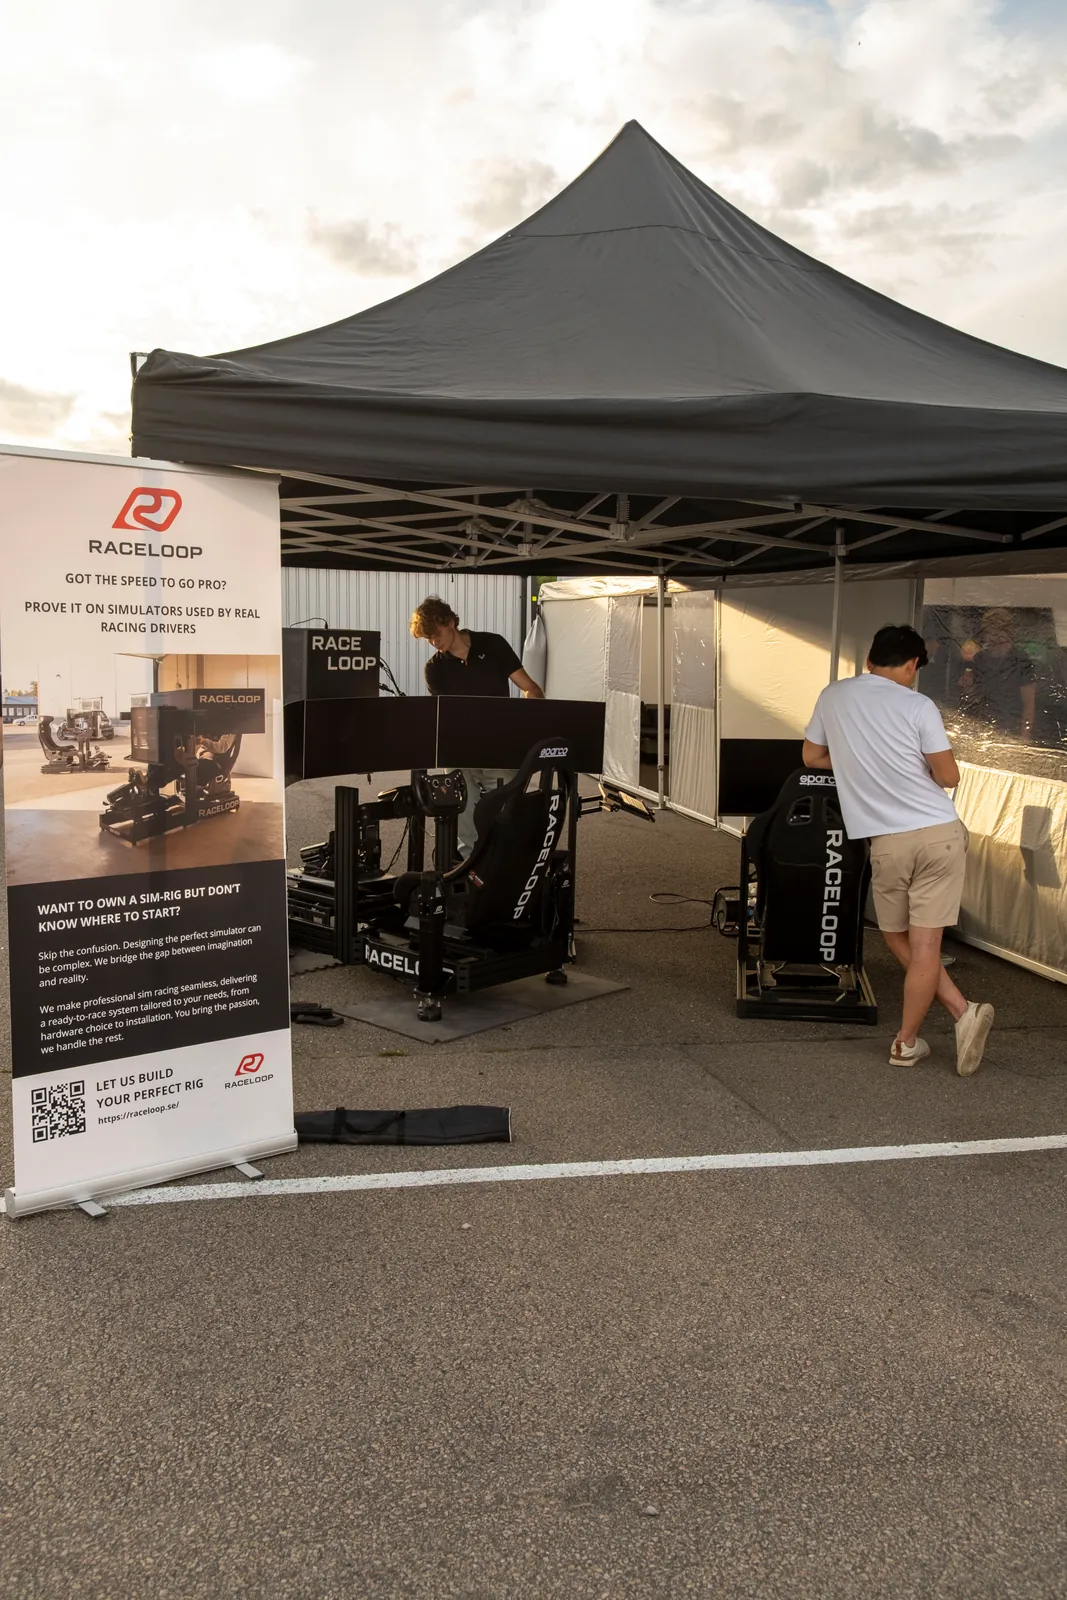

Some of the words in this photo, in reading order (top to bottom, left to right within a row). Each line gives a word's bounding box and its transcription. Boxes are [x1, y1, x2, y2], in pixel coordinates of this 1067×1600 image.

[89, 540, 202, 559] RACELOOP
[65, 573, 91, 584] GOT
[95, 574, 117, 585] THE
[121, 576, 157, 587] SPEED
[160, 577, 175, 588] TO
[178, 578, 194, 589] GO
[198, 579, 226, 590] PRO?
[25, 601, 66, 613] PROVE
[71, 603, 82, 613] IT
[86, 603, 104, 614] ON
[108, 604, 182, 616] SIMULATORS
[186, 607, 214, 617] USED
[218, 608, 231, 617] BY
[235, 608, 260, 618] REAL
[101, 622, 146, 632] RACING
[150, 623, 196, 634] DRIVERS
[312, 636, 361, 650] RACE
[328, 656, 376, 670] LOOP
[199, 695, 261, 703] RACELOOP
[800, 775, 836, 786] sparc
[198, 799, 239, 817] RACELOOP
[513, 795, 559, 919] RACELOOP
[37, 901, 75, 915] WANT
[77, 900, 93, 910] TO
[97, 896, 125, 908] OWN
[129, 895, 137, 905] A
[140, 890, 181, 904] SIM-RIG
[184, 887, 205, 898] BUT
[208, 883, 240, 896] DON'T
[819, 829, 843, 961] RACELOOP
[39, 918, 77, 932] KNOW
[80, 913, 120, 927] WHERE
[123, 911, 139, 922] TO
[142, 906, 180, 920] START?
[38, 951, 57, 961] Skip
[59, 949, 74, 957] the
[76, 943, 120, 955] confusion.
[123, 937, 163, 949] Designing
[165, 935, 178, 943] the
[180, 931, 208, 943] perfect
[210, 927, 246, 937] simulator
[39, 966, 50, 974] be
[52, 960, 92, 972] complex.
[94, 957, 108, 966] We
[110, 954, 137, 964] bridge
[139, 951, 153, 960] the
[154, 950, 170, 960] gap
[172, 945, 205, 955] between
[207, 938, 252, 950] imagination
[39, 977, 56, 987] and
[59, 974, 88, 984] reality.
[39, 1005, 54, 1014] We
[57, 1001, 81, 1011] make
[83, 991, 135, 1009] professional
[137, 990, 152, 999] sim
[154, 986, 179, 996] racing
[180, 980, 218, 992] seamless,
[220, 974, 257, 986] delivering
[48, 1011, 106, 1026] ready-to-race
[108, 1006, 138, 1018] system
[140, 998, 171, 1011] tailored
[183, 995, 202, 1006] your
[204, 990, 229, 1000] needs,
[231, 988, 249, 996] from
[40, 1028, 83, 1041] hardware
[85, 1022, 113, 1033] choice
[126, 1013, 173, 1026] installation.
[174, 1010, 190, 1018] You
[192, 1006, 213, 1015] bring
[214, 1003, 227, 1011] the
[228, 998, 259, 1011] passion,
[40, 1046, 54, 1054] we
[56, 1039, 87, 1051] handle
[88, 1037, 103, 1045] the
[105, 1033, 124, 1043] rest.
[96, 1078, 116, 1091] LET
[120, 1075, 135, 1087] US
[139, 1068, 173, 1083] BUILD
[224, 1074, 273, 1089] RACELOOP
[96, 1093, 130, 1108] YOUR
[134, 1082, 181, 1101] PERFECT
[185, 1078, 203, 1091] RIG
[98, 1101, 179, 1124] https://raceloop.se/
